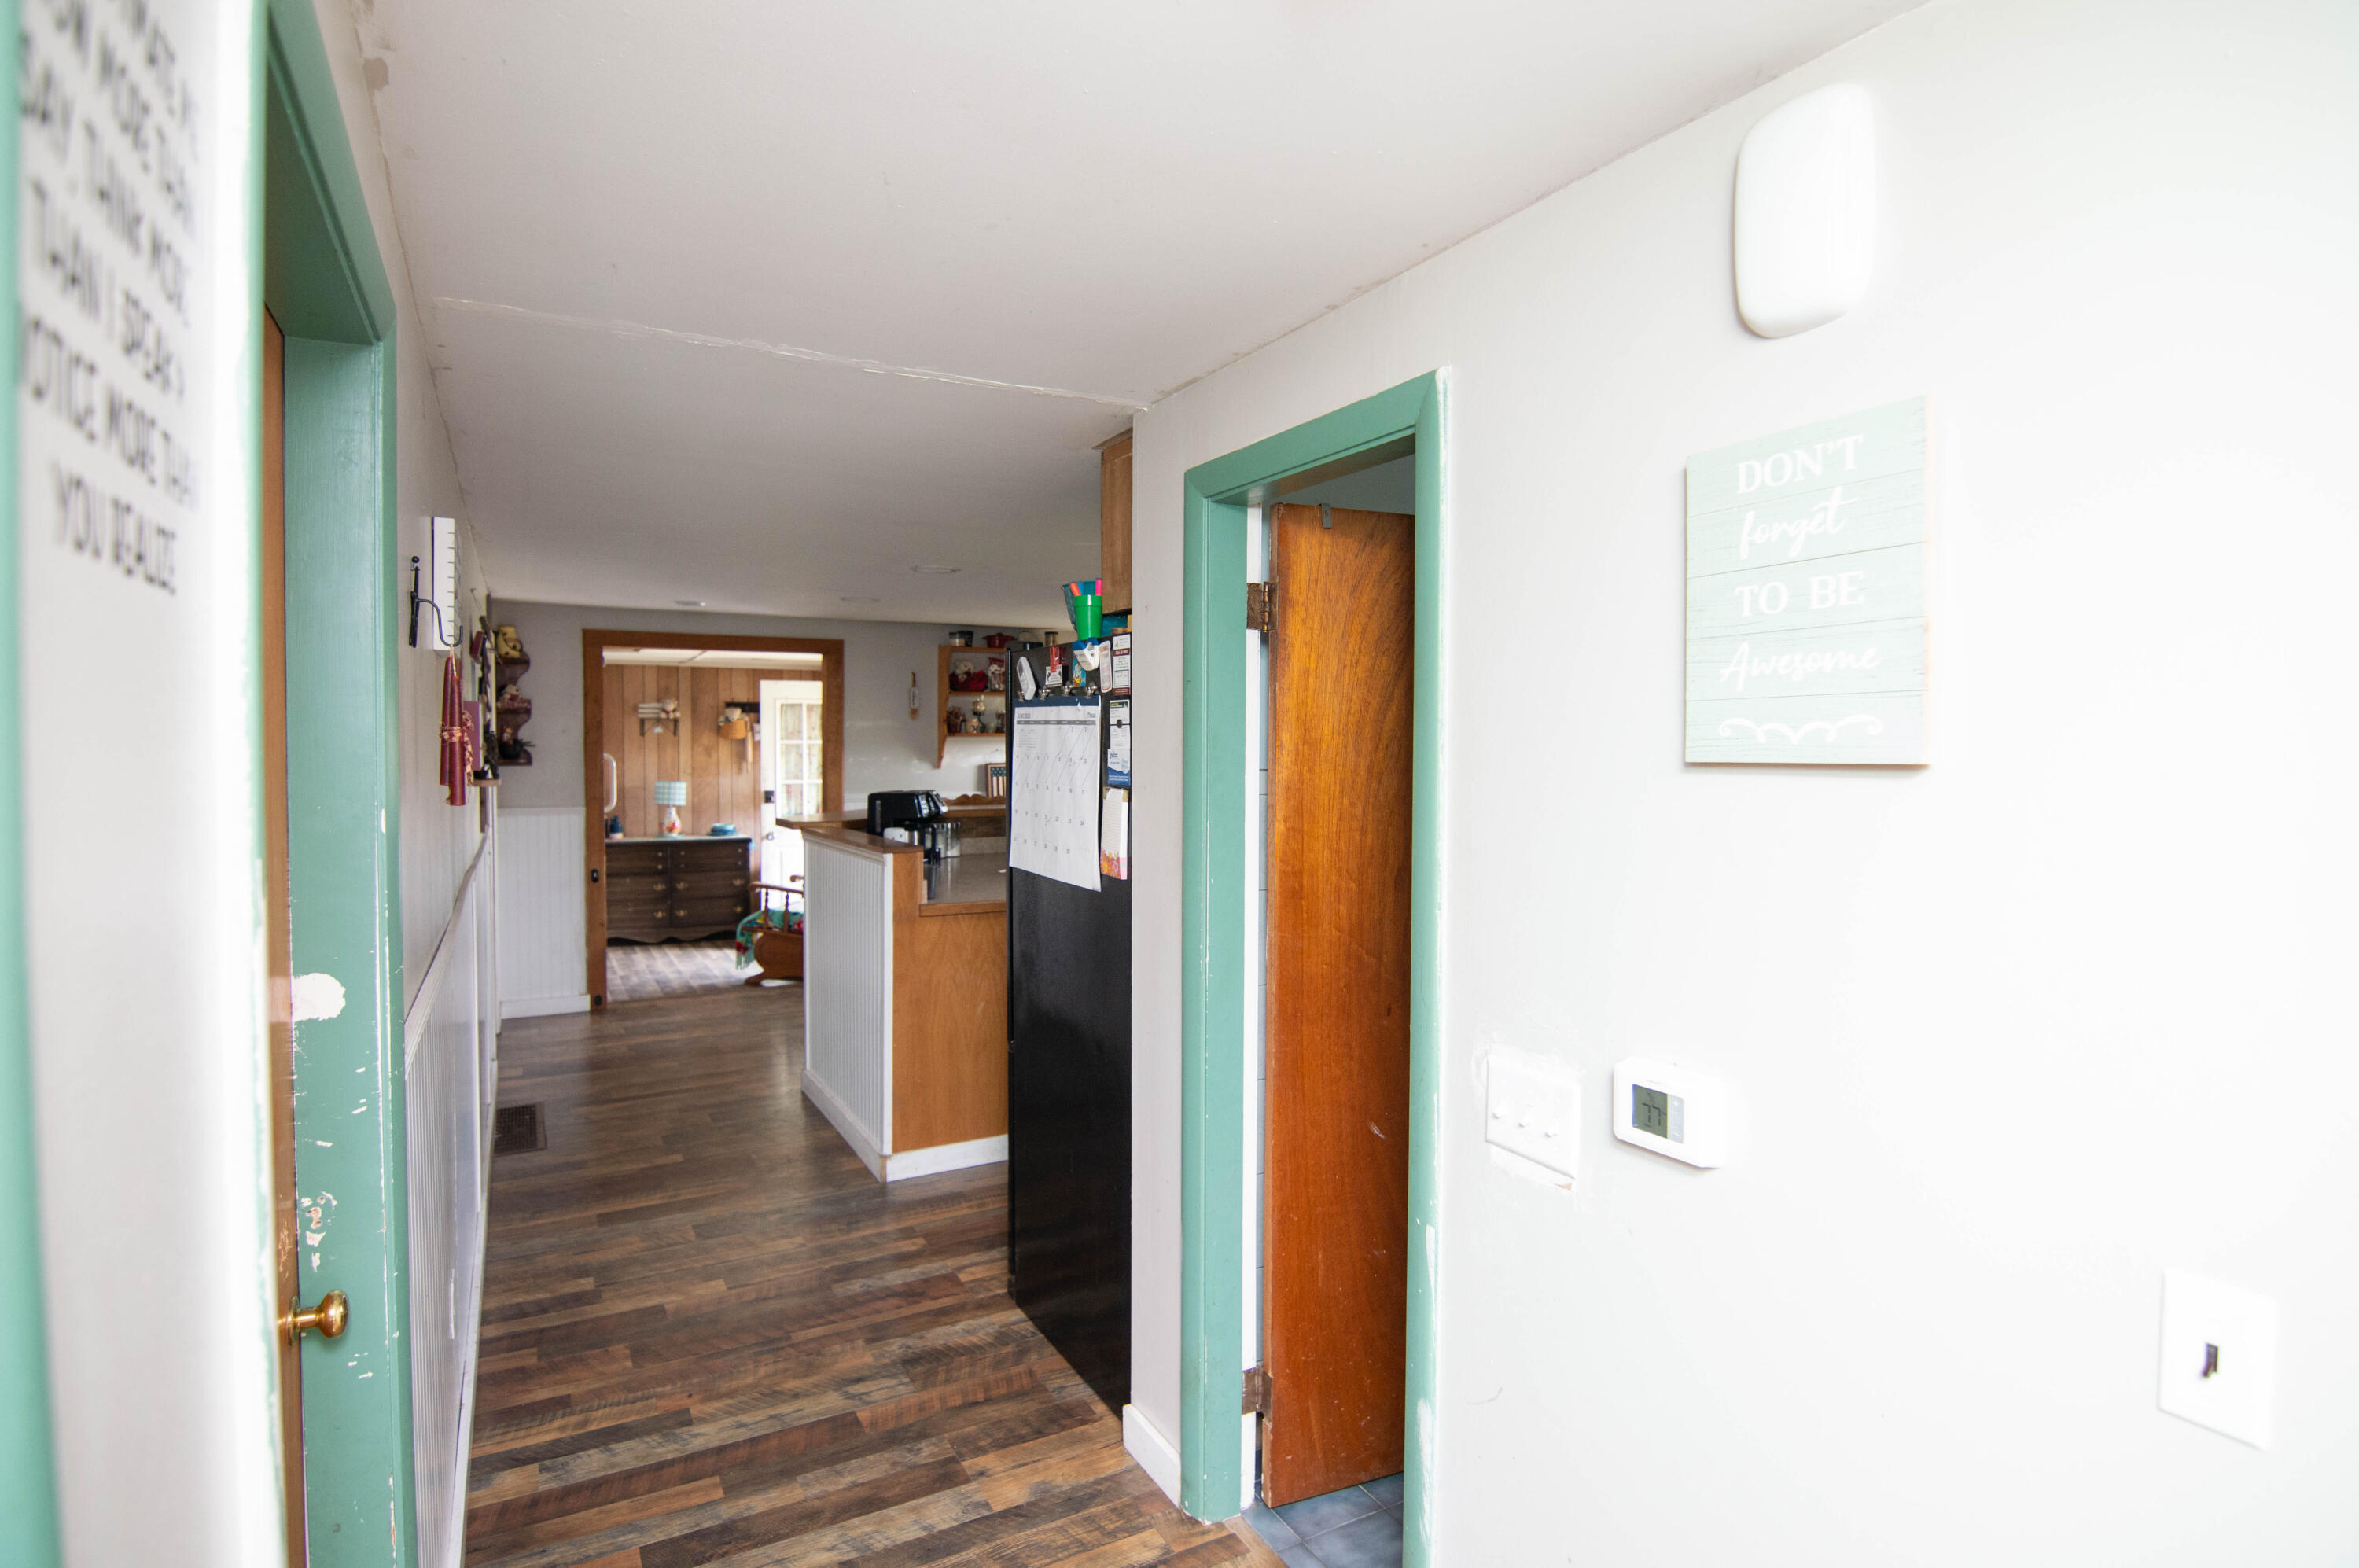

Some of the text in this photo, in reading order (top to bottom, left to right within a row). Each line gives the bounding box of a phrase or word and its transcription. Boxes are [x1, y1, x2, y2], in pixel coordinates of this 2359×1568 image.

[104, 383, 159, 486] MORE
[1736, 434, 1864, 493] DON'T
[53, 460, 177, 596] YOU REALIZE
[1739, 484, 1859, 561] forget
[1735, 570, 1865, 617] TO BE
[1719, 641, 1882, 693] Awesome
[1642, 1102, 1662, 1127] 77
